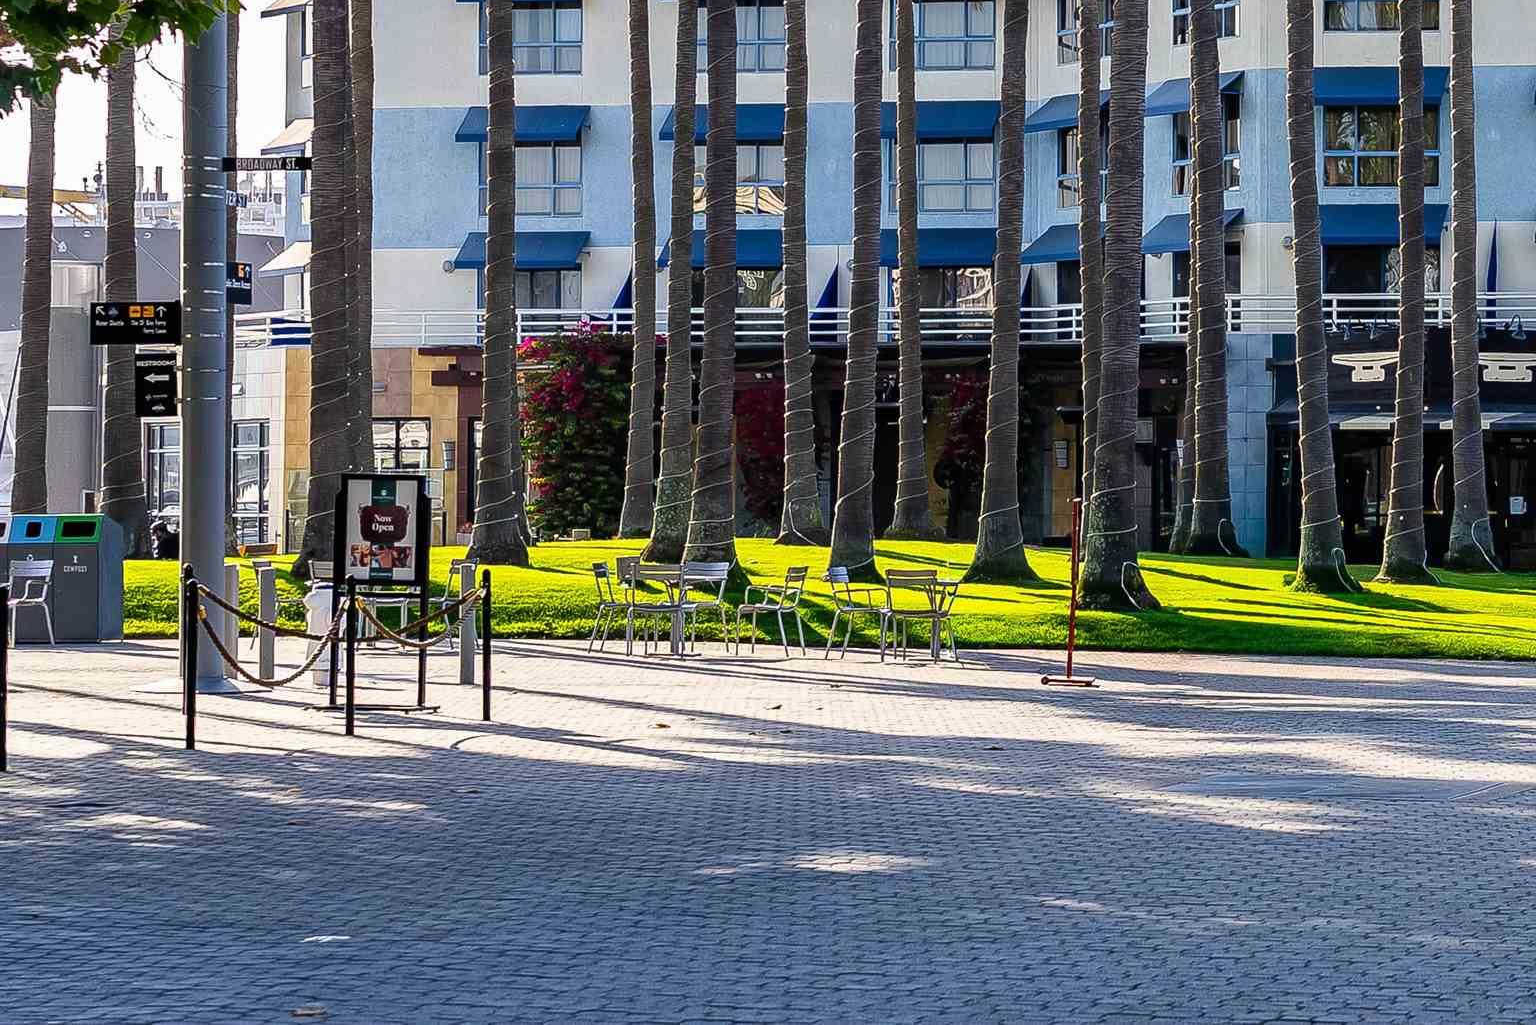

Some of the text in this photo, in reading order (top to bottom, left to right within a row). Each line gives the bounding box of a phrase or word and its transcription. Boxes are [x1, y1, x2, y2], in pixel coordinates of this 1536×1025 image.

[236, 157, 299, 170] BROADWAY ST.
[374, 514, 392, 523] Now
[372, 523, 394, 534] Open
